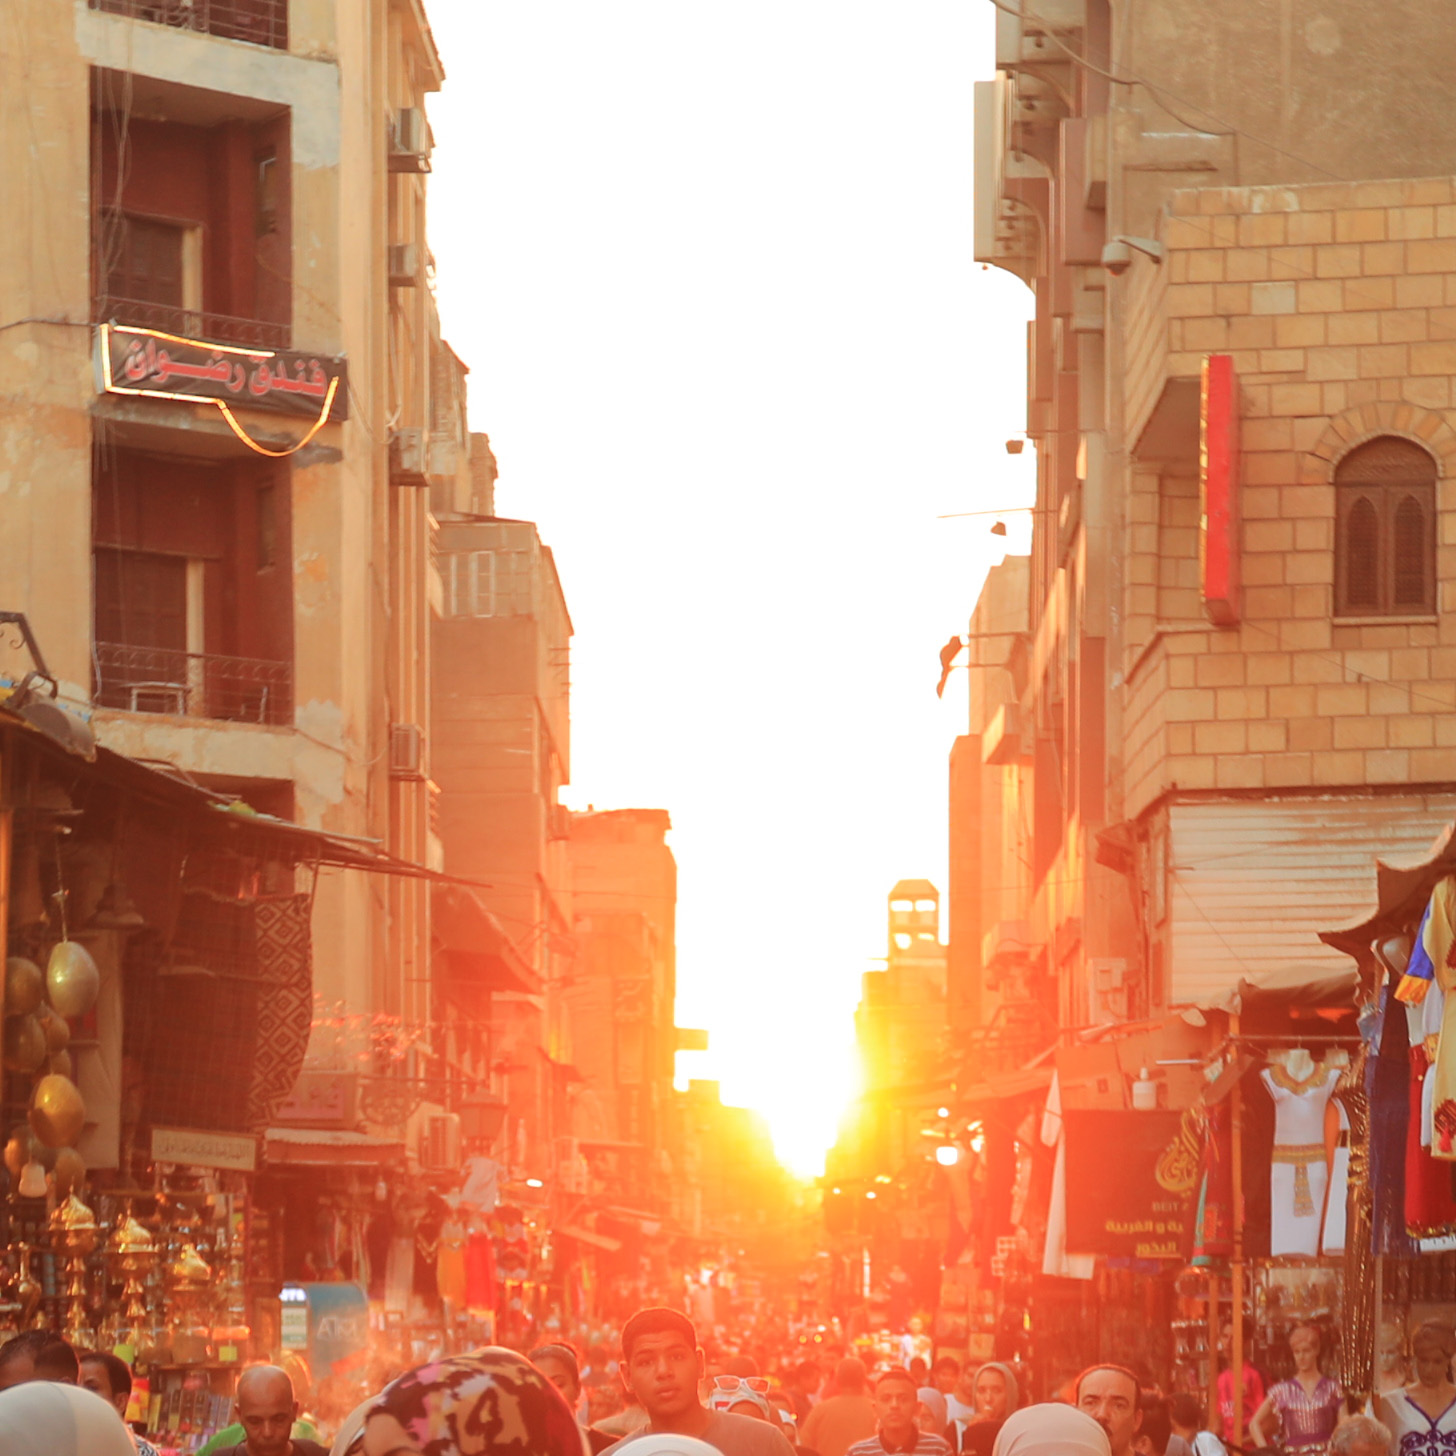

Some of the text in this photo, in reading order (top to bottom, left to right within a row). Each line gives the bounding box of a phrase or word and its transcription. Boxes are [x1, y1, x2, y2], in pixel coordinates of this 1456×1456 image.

[124, 338, 327, 396] فندق رضوان
[317, 1316, 356, 1340] ATM
